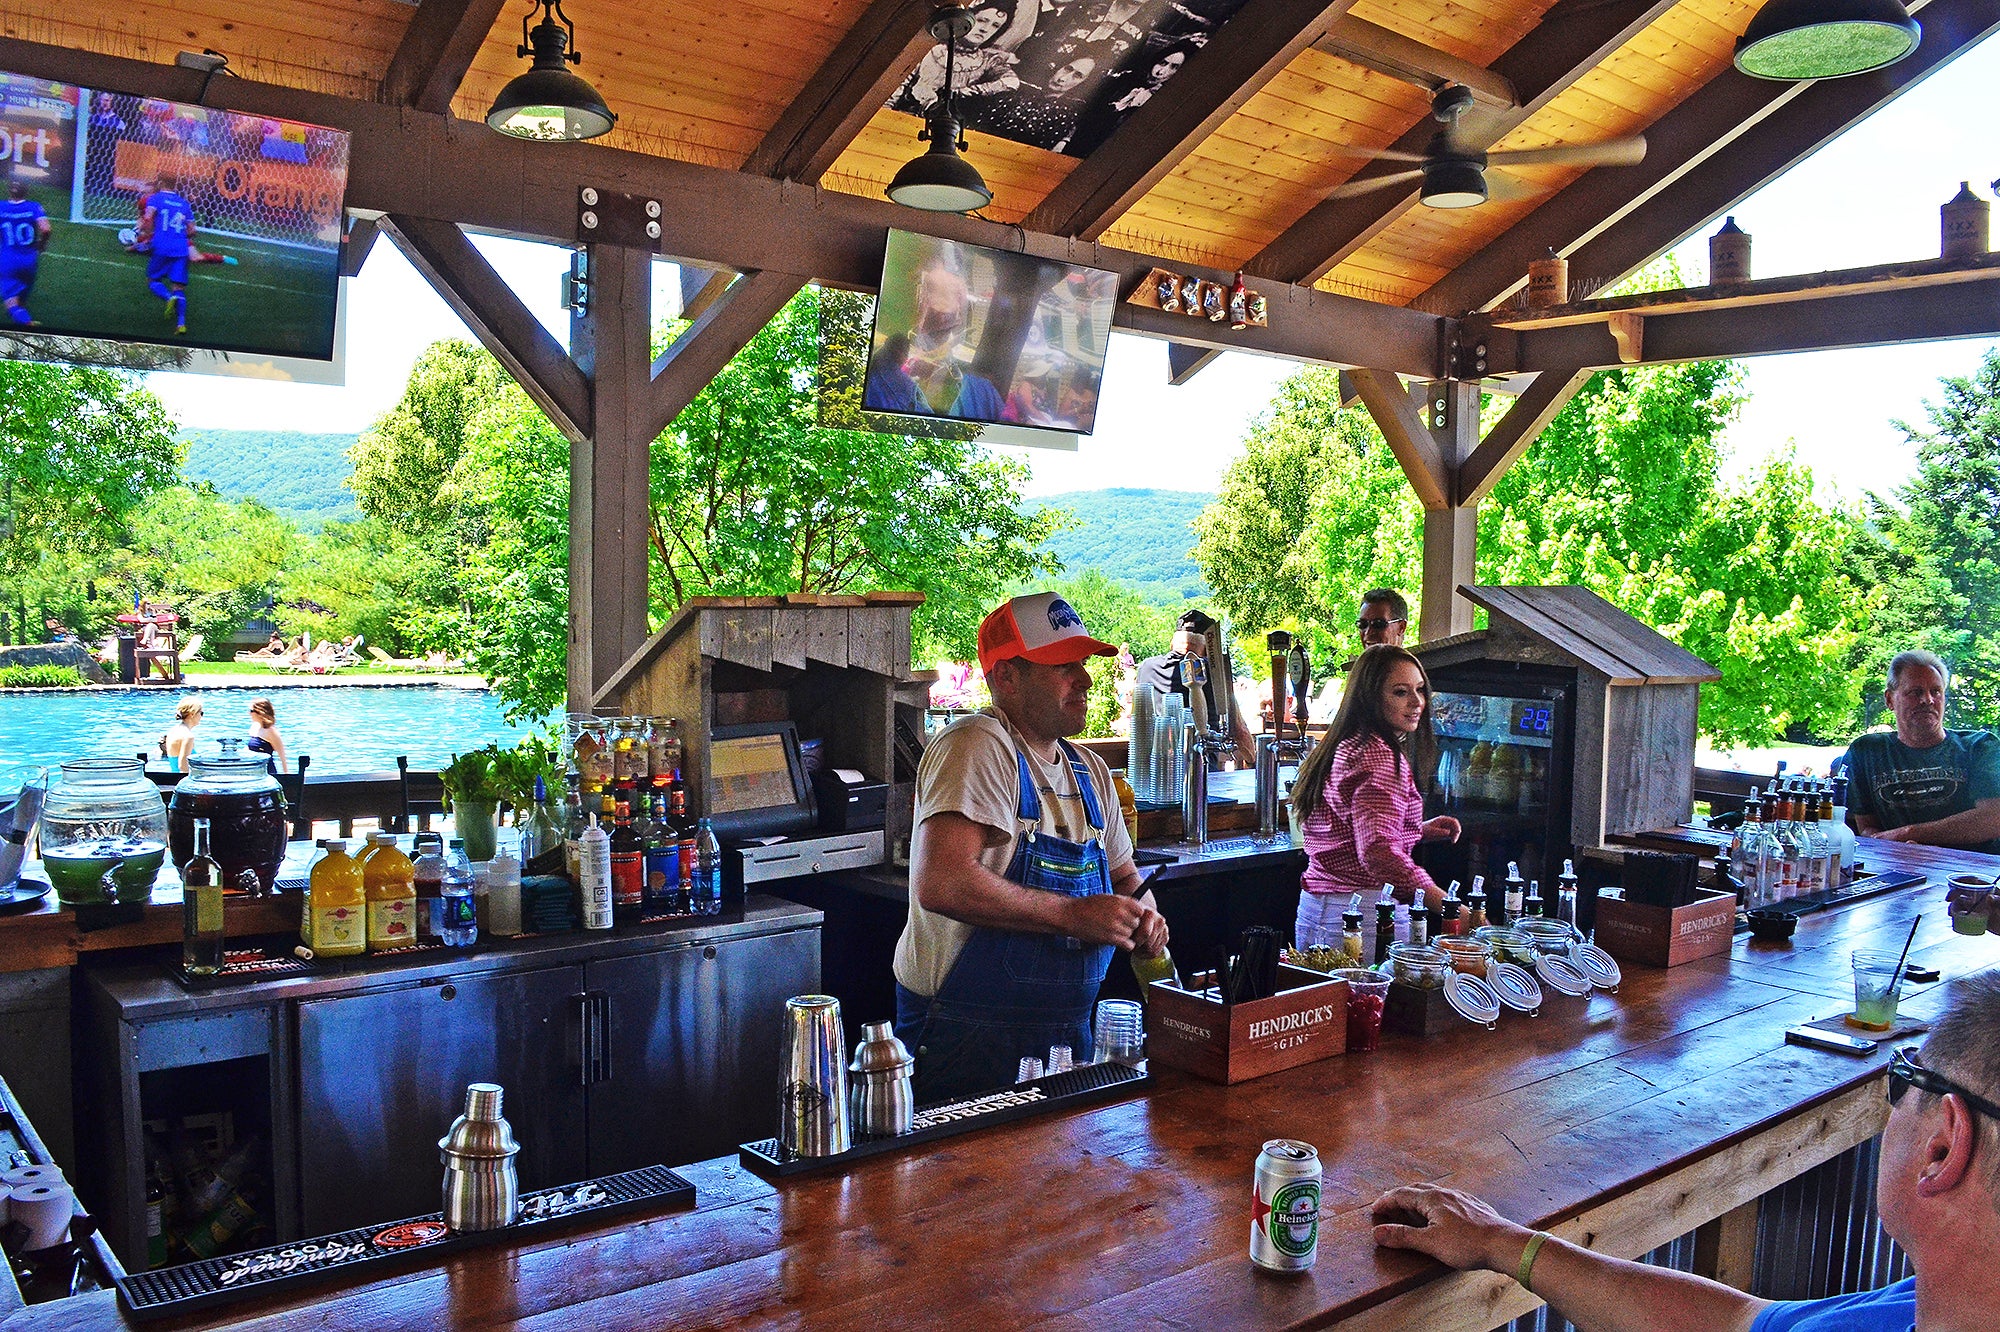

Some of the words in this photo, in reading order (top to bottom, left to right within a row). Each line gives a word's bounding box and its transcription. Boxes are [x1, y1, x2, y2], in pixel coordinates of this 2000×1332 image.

[160, 208, 186, 235] 14
[1519, 707, 1550, 731] 28
[1680, 911, 1728, 935] HENDRICK'S
[1163, 1016, 1211, 1039] HENDRICK'S
[1249, 1004, 1333, 1040] HENDRICK'S
[1279, 1034, 1303, 1050] GIN
[220, 1242, 366, 1285] Handmade
[232, 1240, 345, 1268] VODKA
